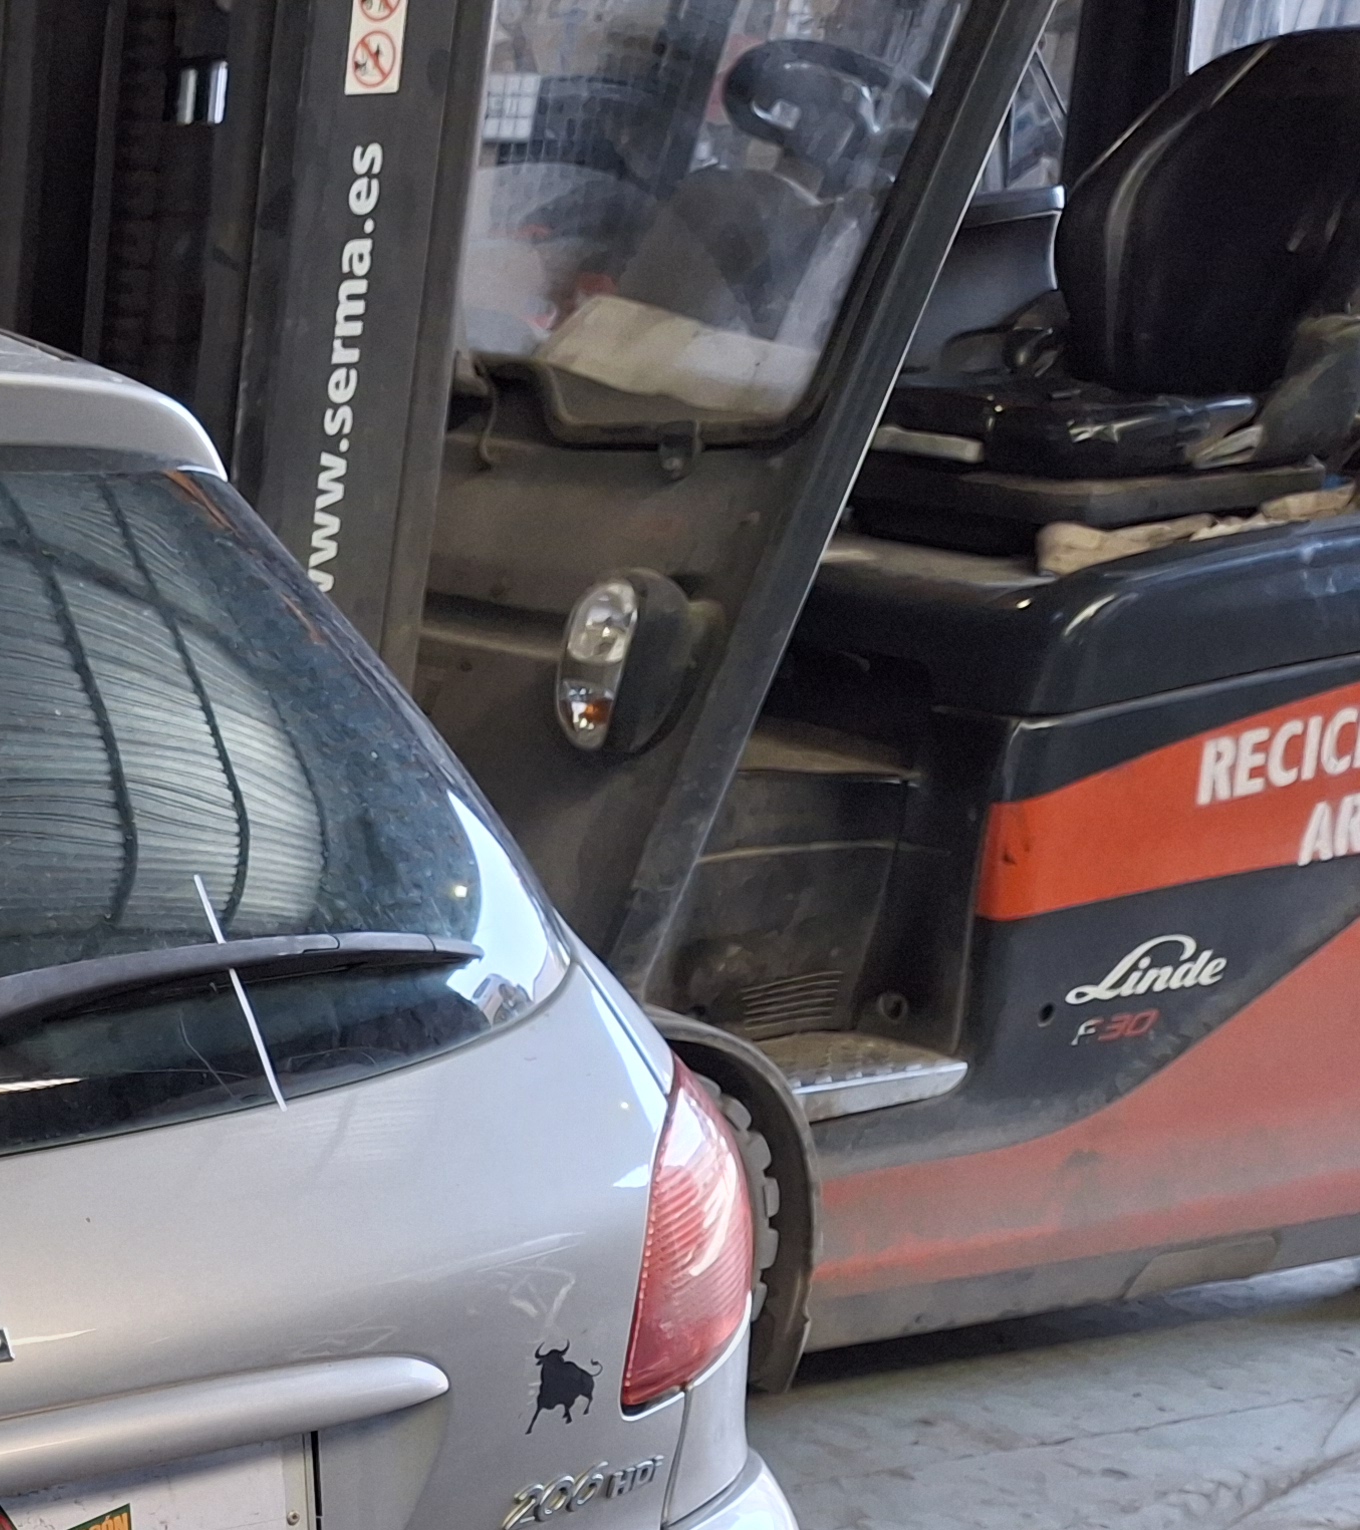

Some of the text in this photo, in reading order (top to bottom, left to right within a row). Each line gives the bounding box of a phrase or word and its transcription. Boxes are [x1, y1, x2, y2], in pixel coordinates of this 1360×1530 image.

[1196, 706, 1360, 806] RECIC
[1064, 933, 1227, 1005] Linde
[1070, 1008, 1160, 1046] F30
